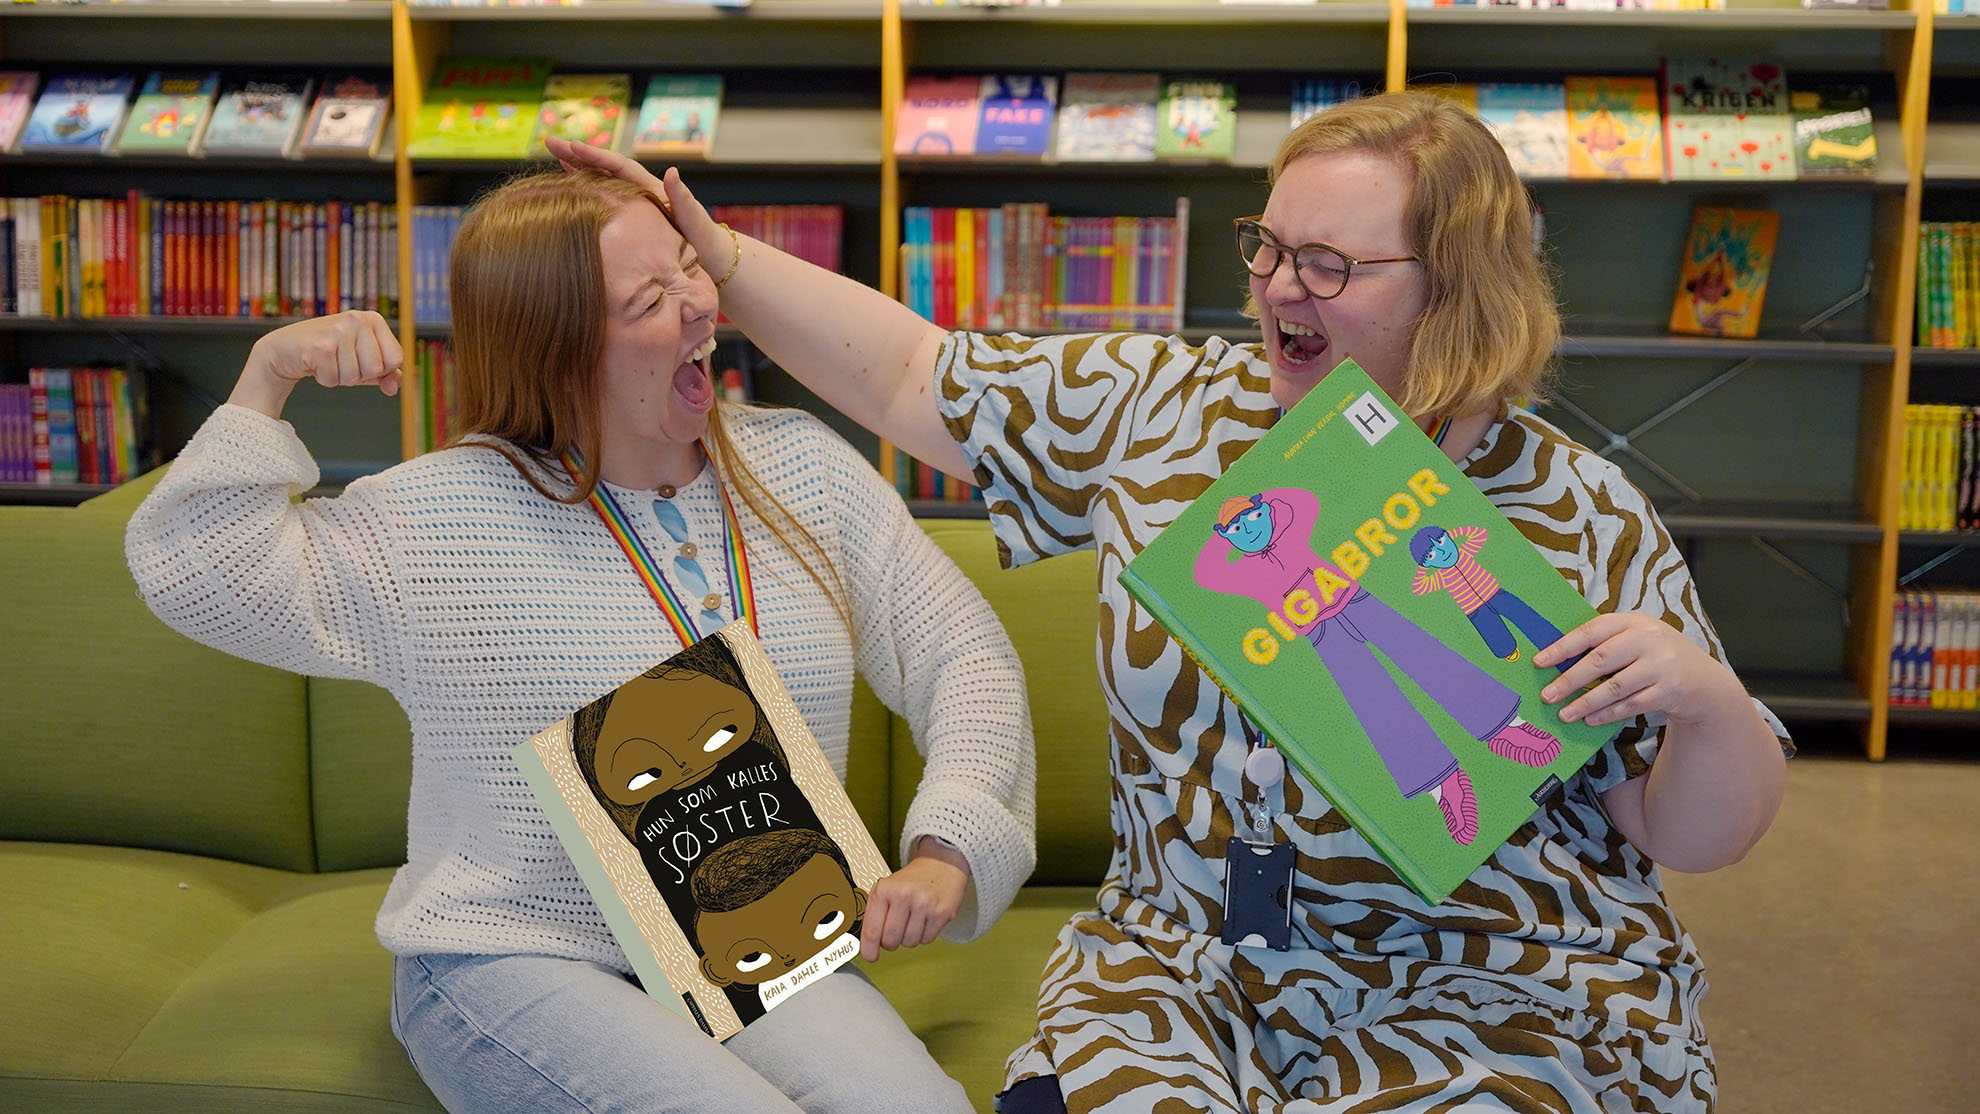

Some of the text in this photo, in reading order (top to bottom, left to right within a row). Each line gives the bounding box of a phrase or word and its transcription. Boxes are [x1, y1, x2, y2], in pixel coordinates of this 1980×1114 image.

[985, 107, 1045, 124] FAKE
[1682, 91, 1776, 108] KRIGEN
[1355, 402, 1387, 435] H
[1242, 468, 1451, 665] GIGABROR
[1174, 636, 1241, 707] GIGABROR
[643, 761, 778, 842] HUN SOM KALLES
[658, 792, 790, 884] SØSTER
[763, 941, 854, 1001] KAIA DAHLE NYHUS
